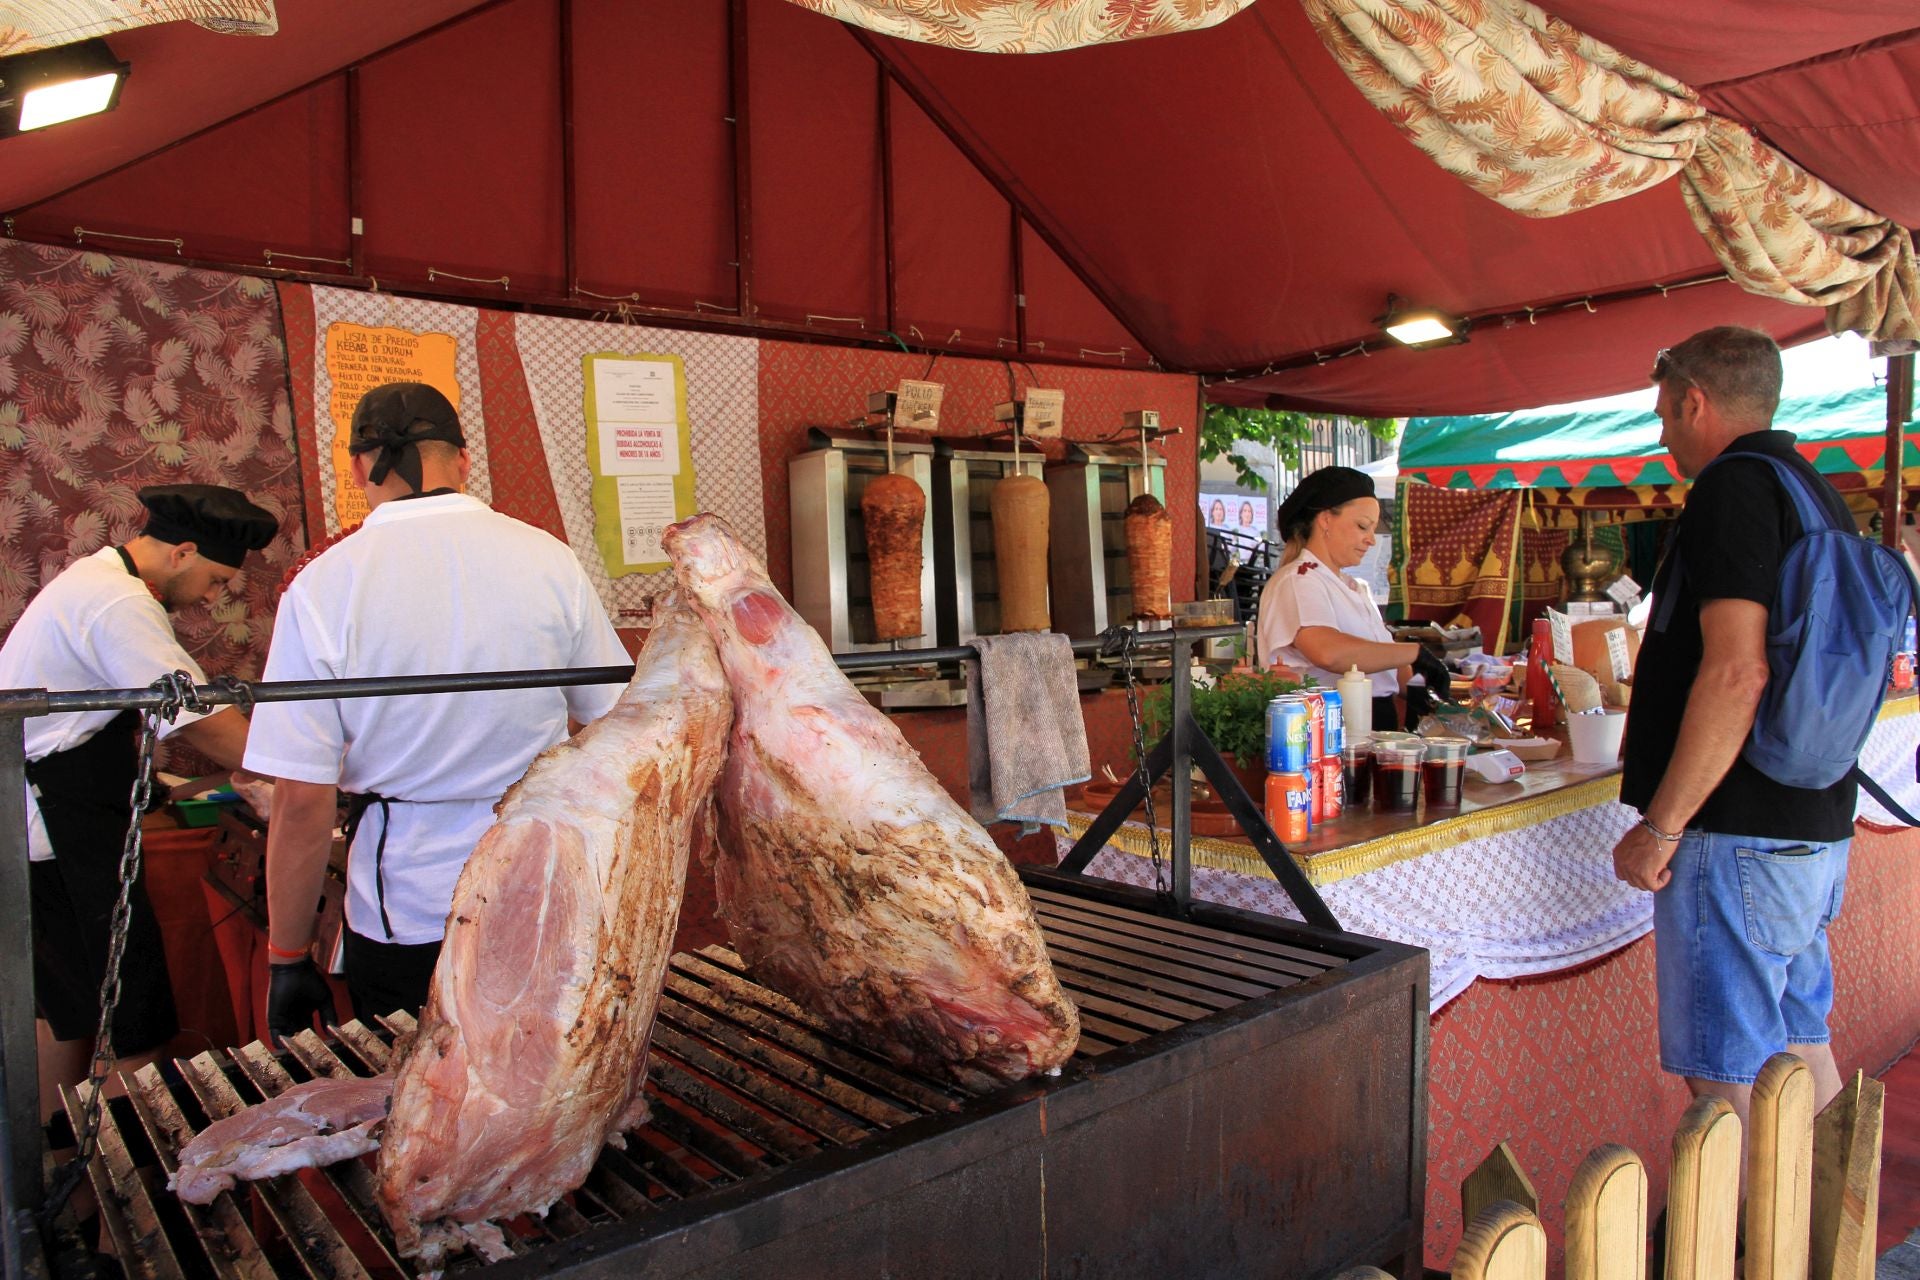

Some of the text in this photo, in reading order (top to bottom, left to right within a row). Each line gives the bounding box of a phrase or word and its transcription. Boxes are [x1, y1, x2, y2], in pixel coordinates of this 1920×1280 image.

[344, 330, 419, 348] LISTA DE PRECIOS
[336, 341, 413, 358] KEBAB O DURUM
[336, 352, 405, 367] POLLO CON VERDURAS
[336, 361, 422, 378] TERNERA CON VERDURAS
[339, 371, 362, 381] MIXTO
[367, 373, 379, 383] CON
[340, 381, 358, 390] POLLO
[904, 384, 933, 400] POLLO
[339, 390, 360, 400] TERNE
[616, 429, 637, 437] PROHIBIDA
[616, 440, 633, 448] BEBIDAS
